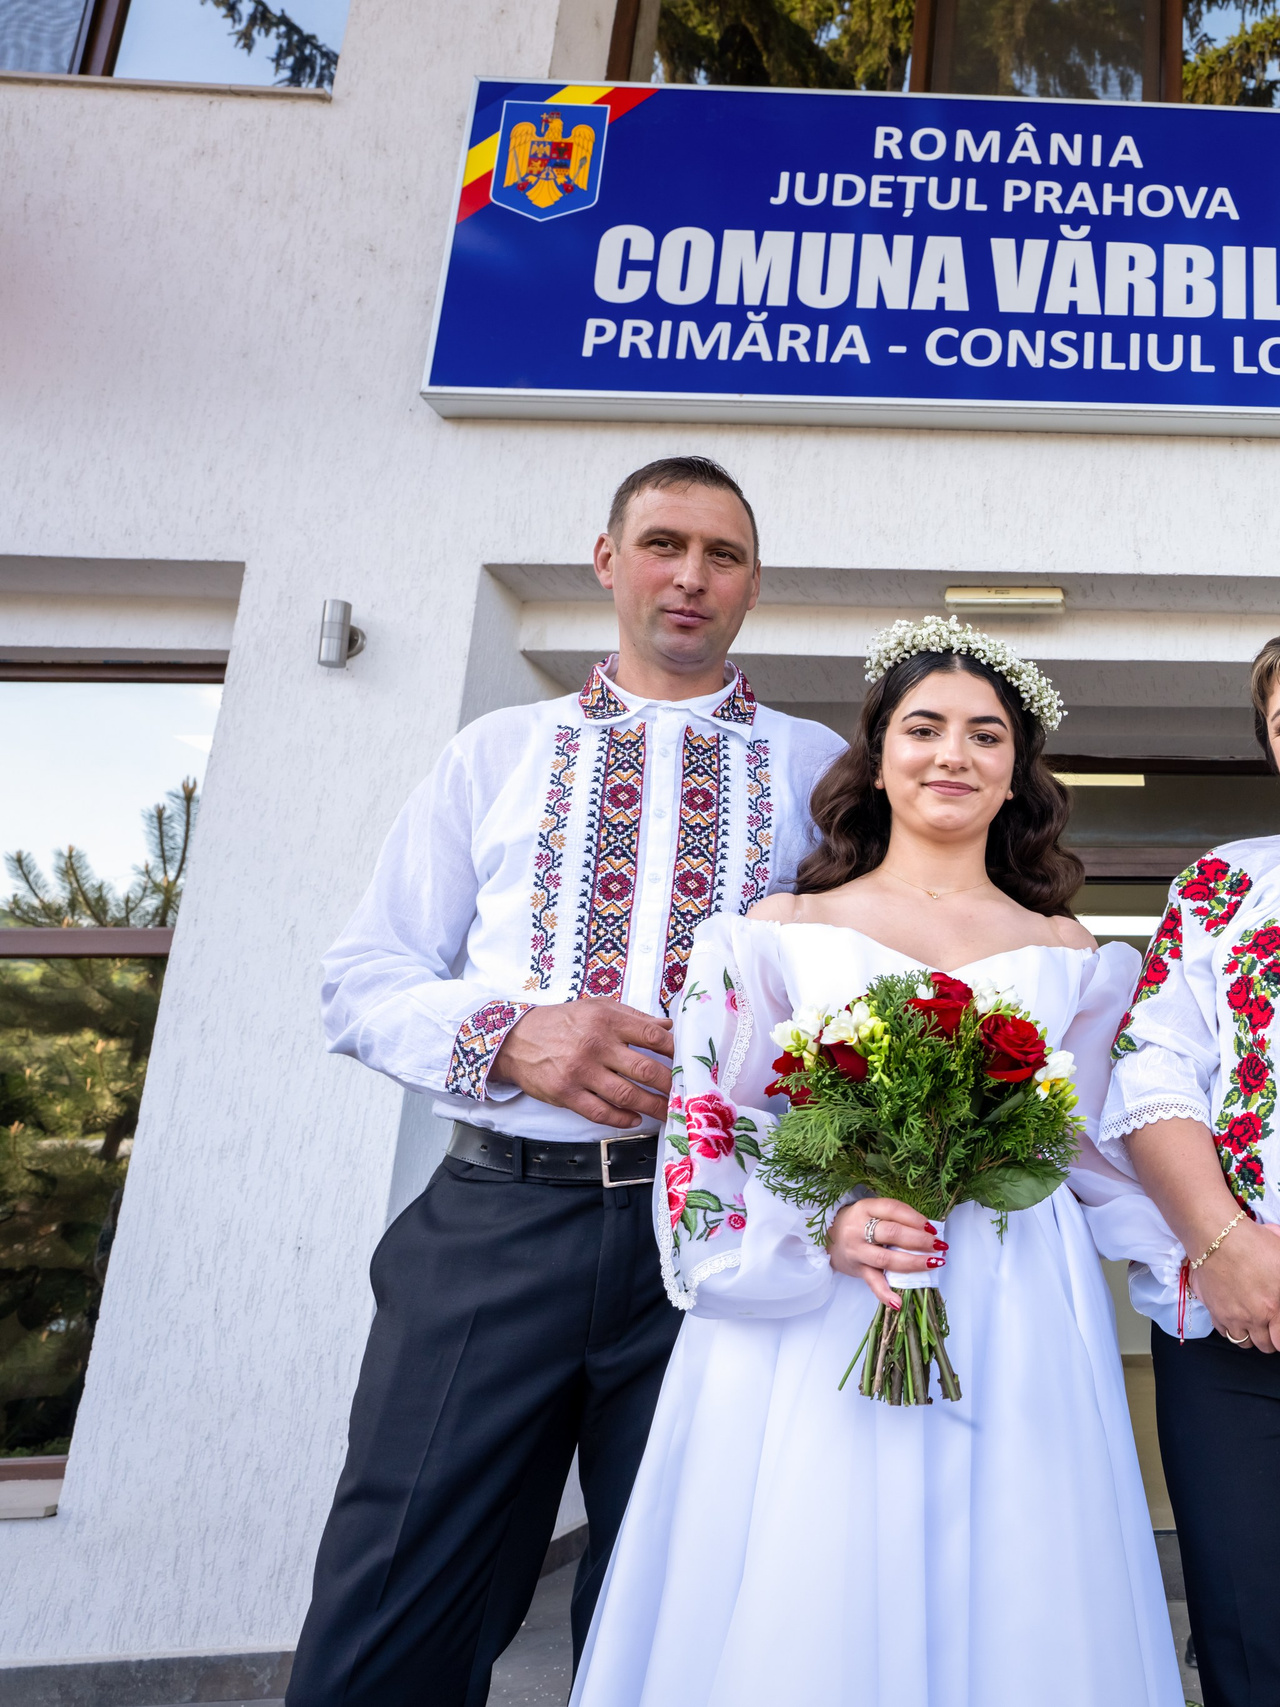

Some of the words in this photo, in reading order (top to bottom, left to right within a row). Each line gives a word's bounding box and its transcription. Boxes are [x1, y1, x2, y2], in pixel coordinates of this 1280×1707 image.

[873, 122, 1145, 169] ROMÂNIA
[768, 171, 988, 218] JUDEȚUL
[1003, 179, 1240, 220] PRAHOVA
[594, 224, 970, 311] COMUNA
[582, 311, 871, 364] PRIMĂRIA
[925, 327, 1216, 373] CONSILIUL
